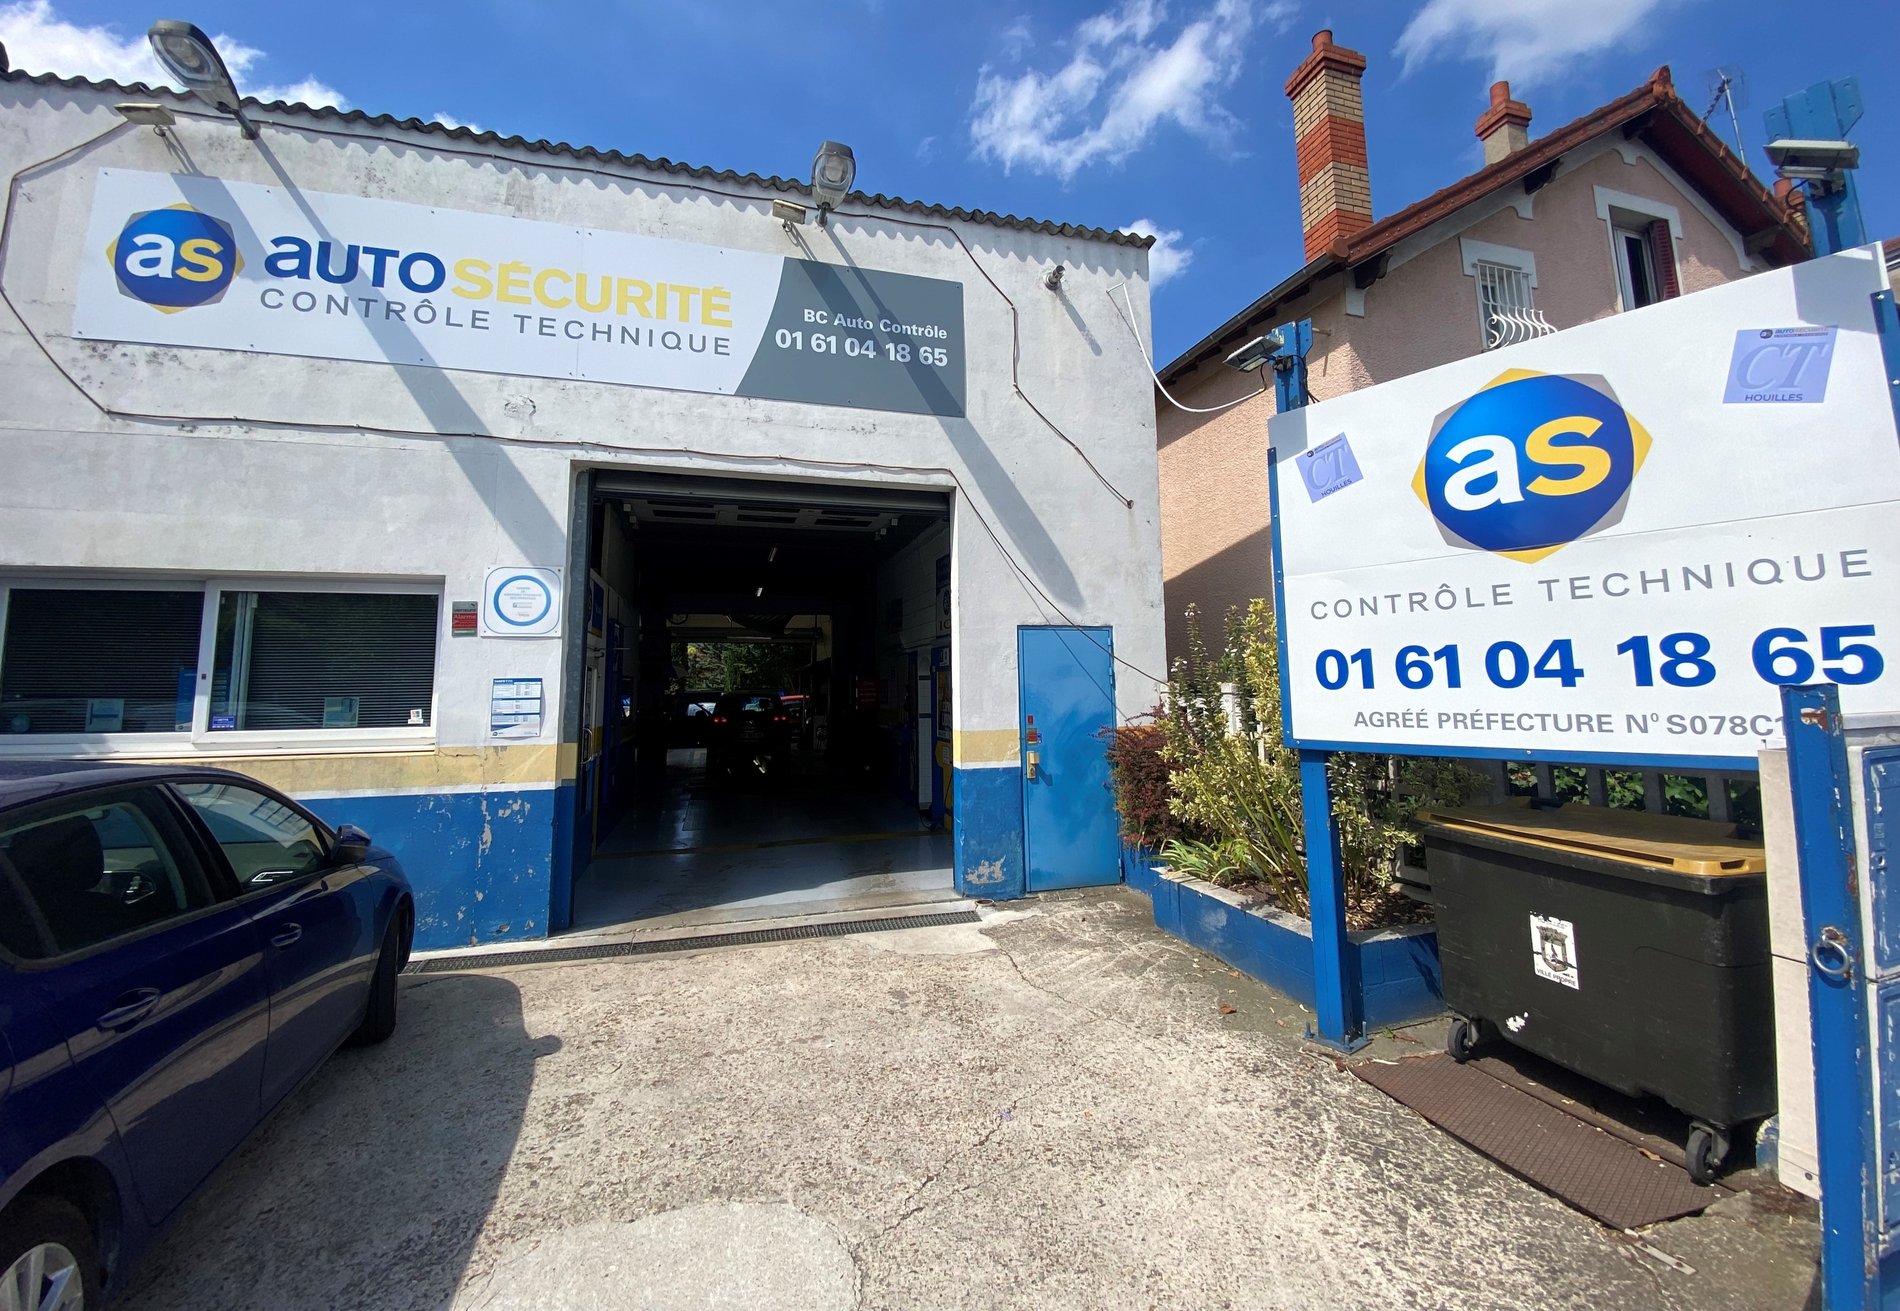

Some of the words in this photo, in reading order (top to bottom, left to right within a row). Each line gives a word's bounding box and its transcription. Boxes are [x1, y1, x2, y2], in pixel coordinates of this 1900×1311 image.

[125, 233, 223, 282] as
[260, 288, 490, 330] CONTRÔLE
[513, 314, 731, 356] TECHNIQUE
[803, 309, 828, 324] BC
[833, 313, 874, 330] Auto
[879, 319, 948, 339] Contrôle
[775, 329, 803, 350] 01
[810, 333, 837, 354] 61
[844, 337, 877, 359] 04
[885, 342, 911, 363] 18
[918, 346, 948, 367] 65
[1737, 341, 1831, 392] CT
[1744, 393, 1804, 402] HOUILLES
[1307, 443, 1350, 490] CT
[1443, 415, 1612, 512] as
[1320, 478, 1352, 497] HOUILLES
[1310, 582, 1514, 621] CONTRÔLE
[1537, 549, 1873, 602] TECHNIQUE
[1315, 648, 1375, 690] 01
[1395, 644, 1462, 690] 61
[1484, 639, 1585, 689] 04
[1616, 632, 1717, 688] 18
[1751, 624, 1885, 686] 65
[1353, 709, 1428, 730] AGRÉÉ
[1437, 707, 1615, 734] PRÉFECTURE
[1536, 967, 1553, 978] VILLE
[1553, 974, 1577, 986] PROPRE
